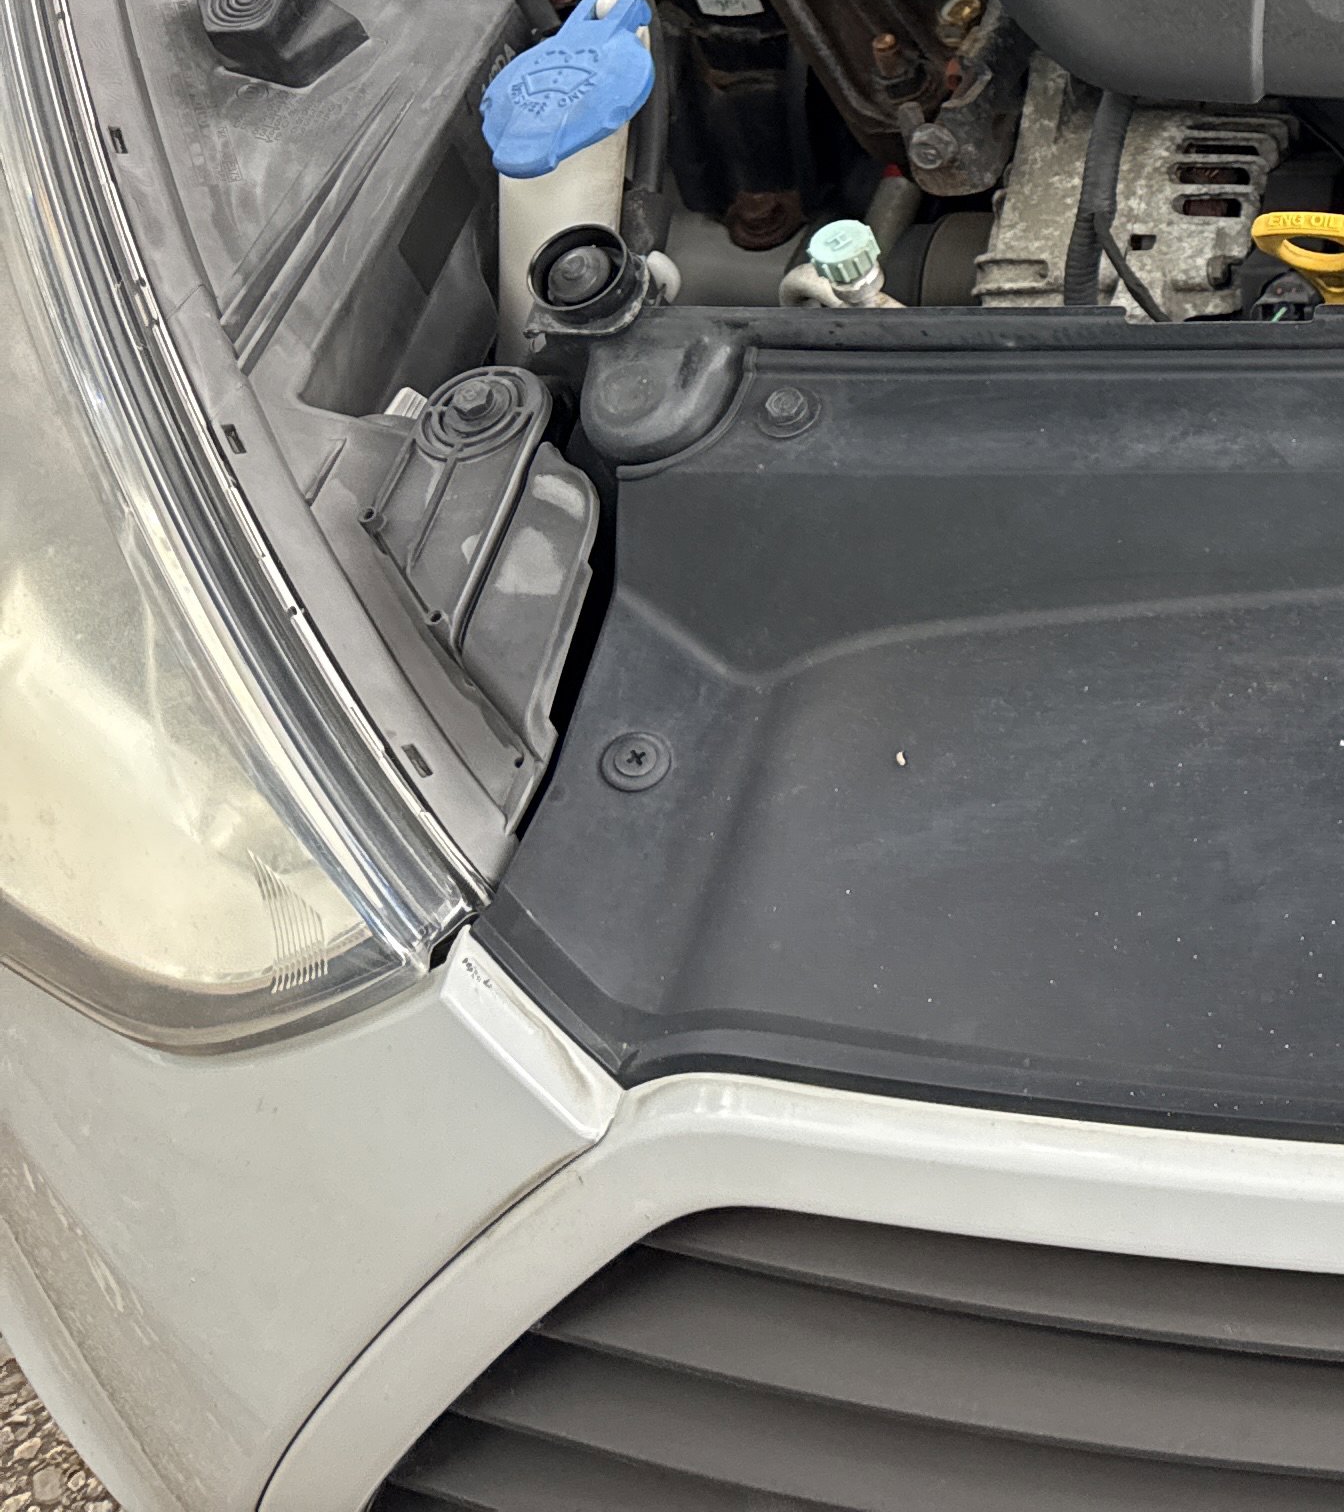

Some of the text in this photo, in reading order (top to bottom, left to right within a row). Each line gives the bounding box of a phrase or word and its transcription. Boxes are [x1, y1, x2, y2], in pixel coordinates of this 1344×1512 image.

[556, 79, 596, 109] ONLY
[1267, 214, 1340, 230] ENG OIL
[824, 231, 853, 252] H
